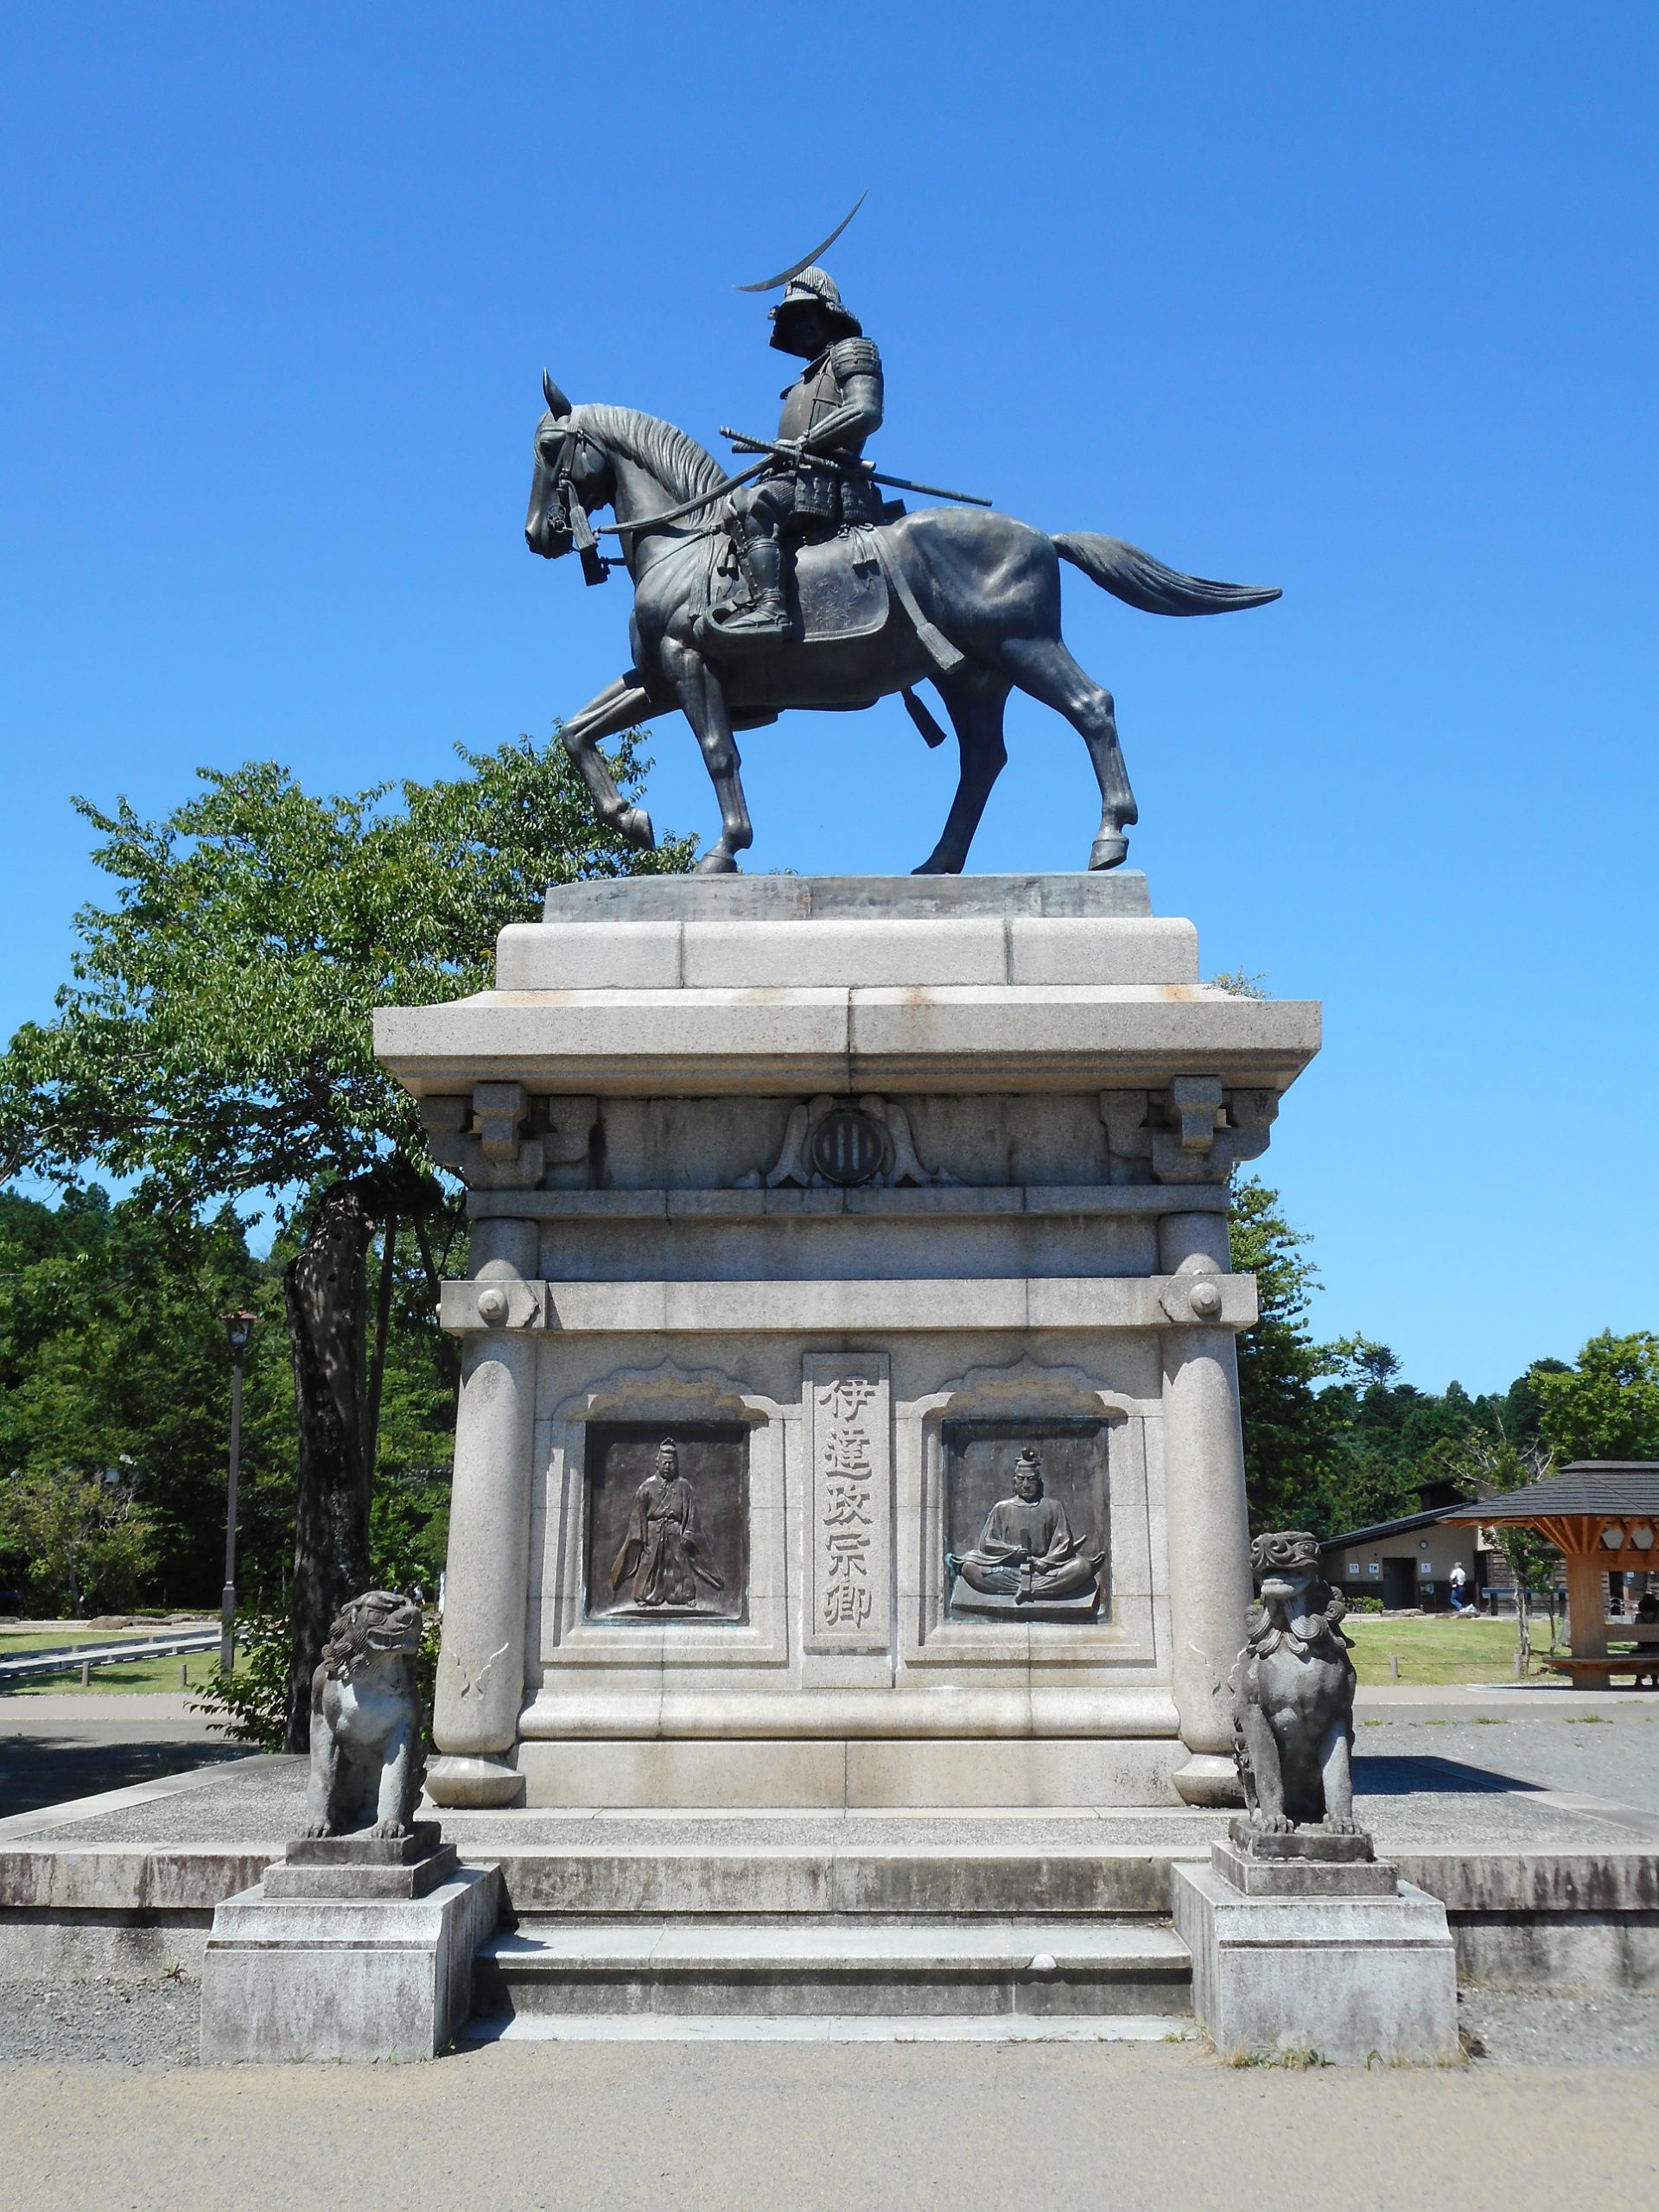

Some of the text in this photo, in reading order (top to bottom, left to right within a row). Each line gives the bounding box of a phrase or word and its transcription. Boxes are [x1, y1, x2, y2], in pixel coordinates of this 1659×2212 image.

[818, 1378, 875, 1629] 伊達政宗卿
